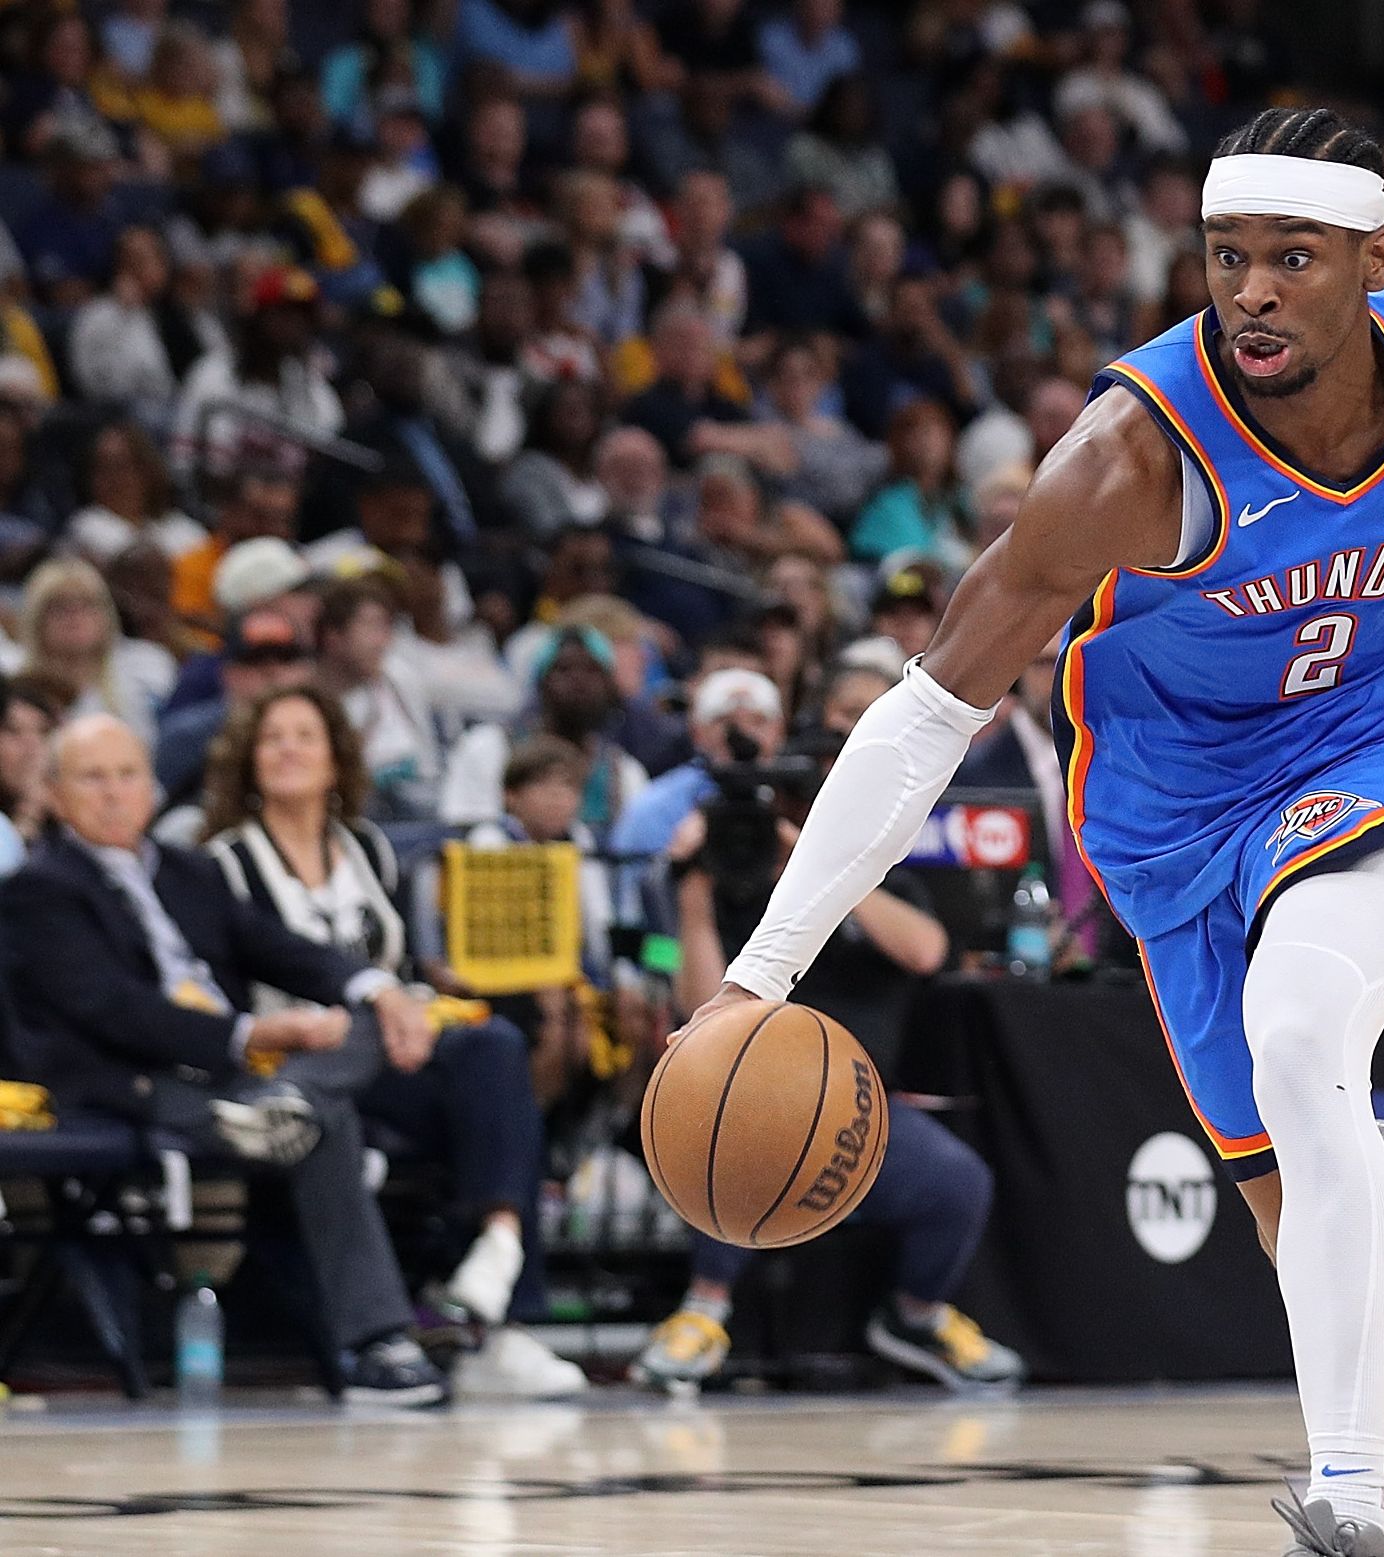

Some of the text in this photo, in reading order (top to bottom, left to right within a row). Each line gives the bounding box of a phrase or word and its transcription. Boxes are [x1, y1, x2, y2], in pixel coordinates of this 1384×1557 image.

[1280, 612, 1359, 700] 2
[1281, 797, 1341, 840] OKC
[796, 1058, 872, 1212] Wilson
